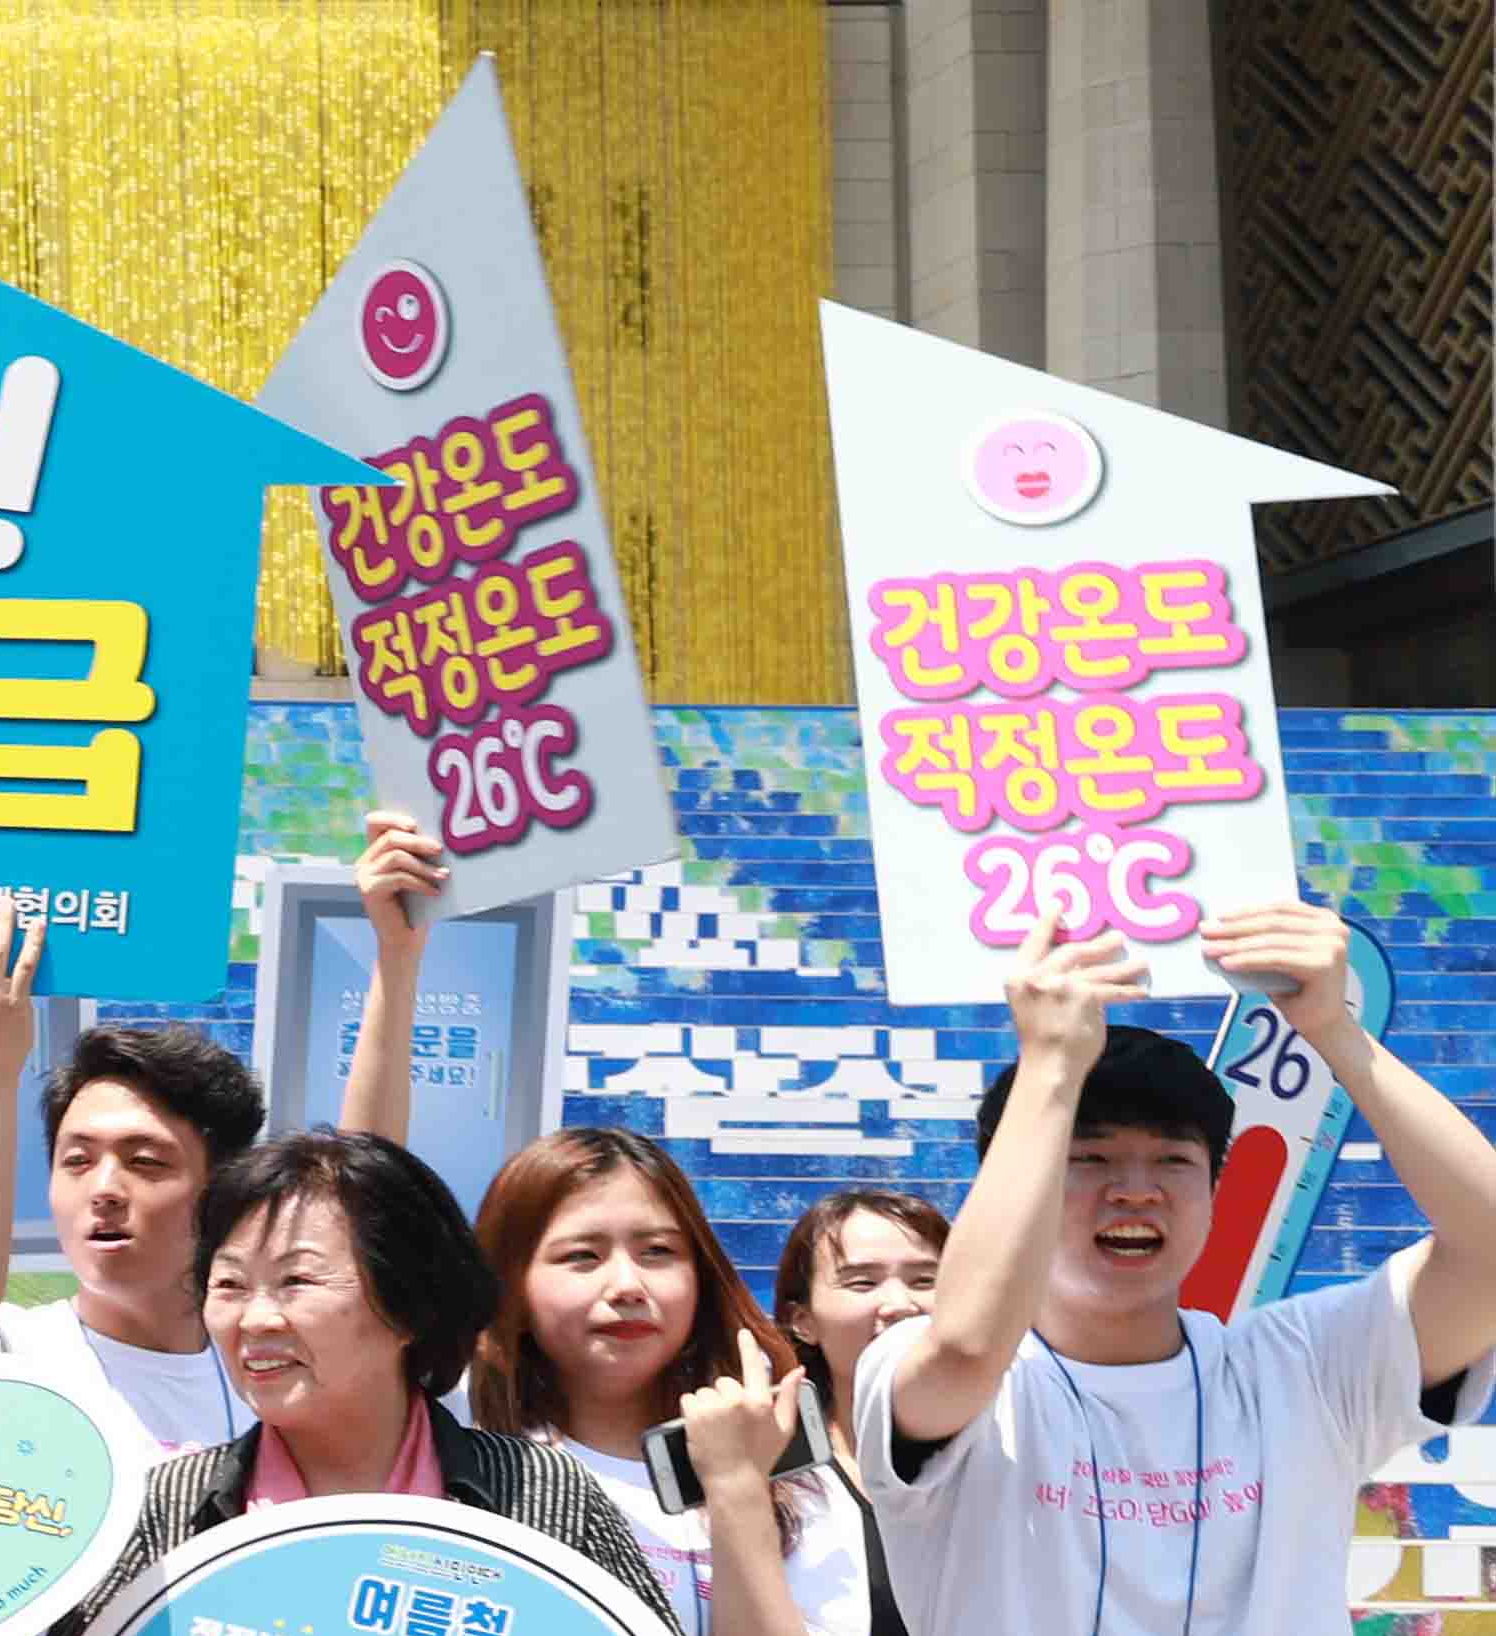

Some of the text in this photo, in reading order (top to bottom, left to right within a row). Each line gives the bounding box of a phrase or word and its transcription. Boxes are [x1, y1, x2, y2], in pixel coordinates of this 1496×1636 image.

[330, 408, 565, 587] 건강온도
[360, 556, 601, 720] 적정온도
[883, 570, 1228, 686] 건강온도
[894, 704, 1242, 818] 적정온도
[1225, 1007, 1310, 1100] 26
[8, 1566, 48, 1605] much
